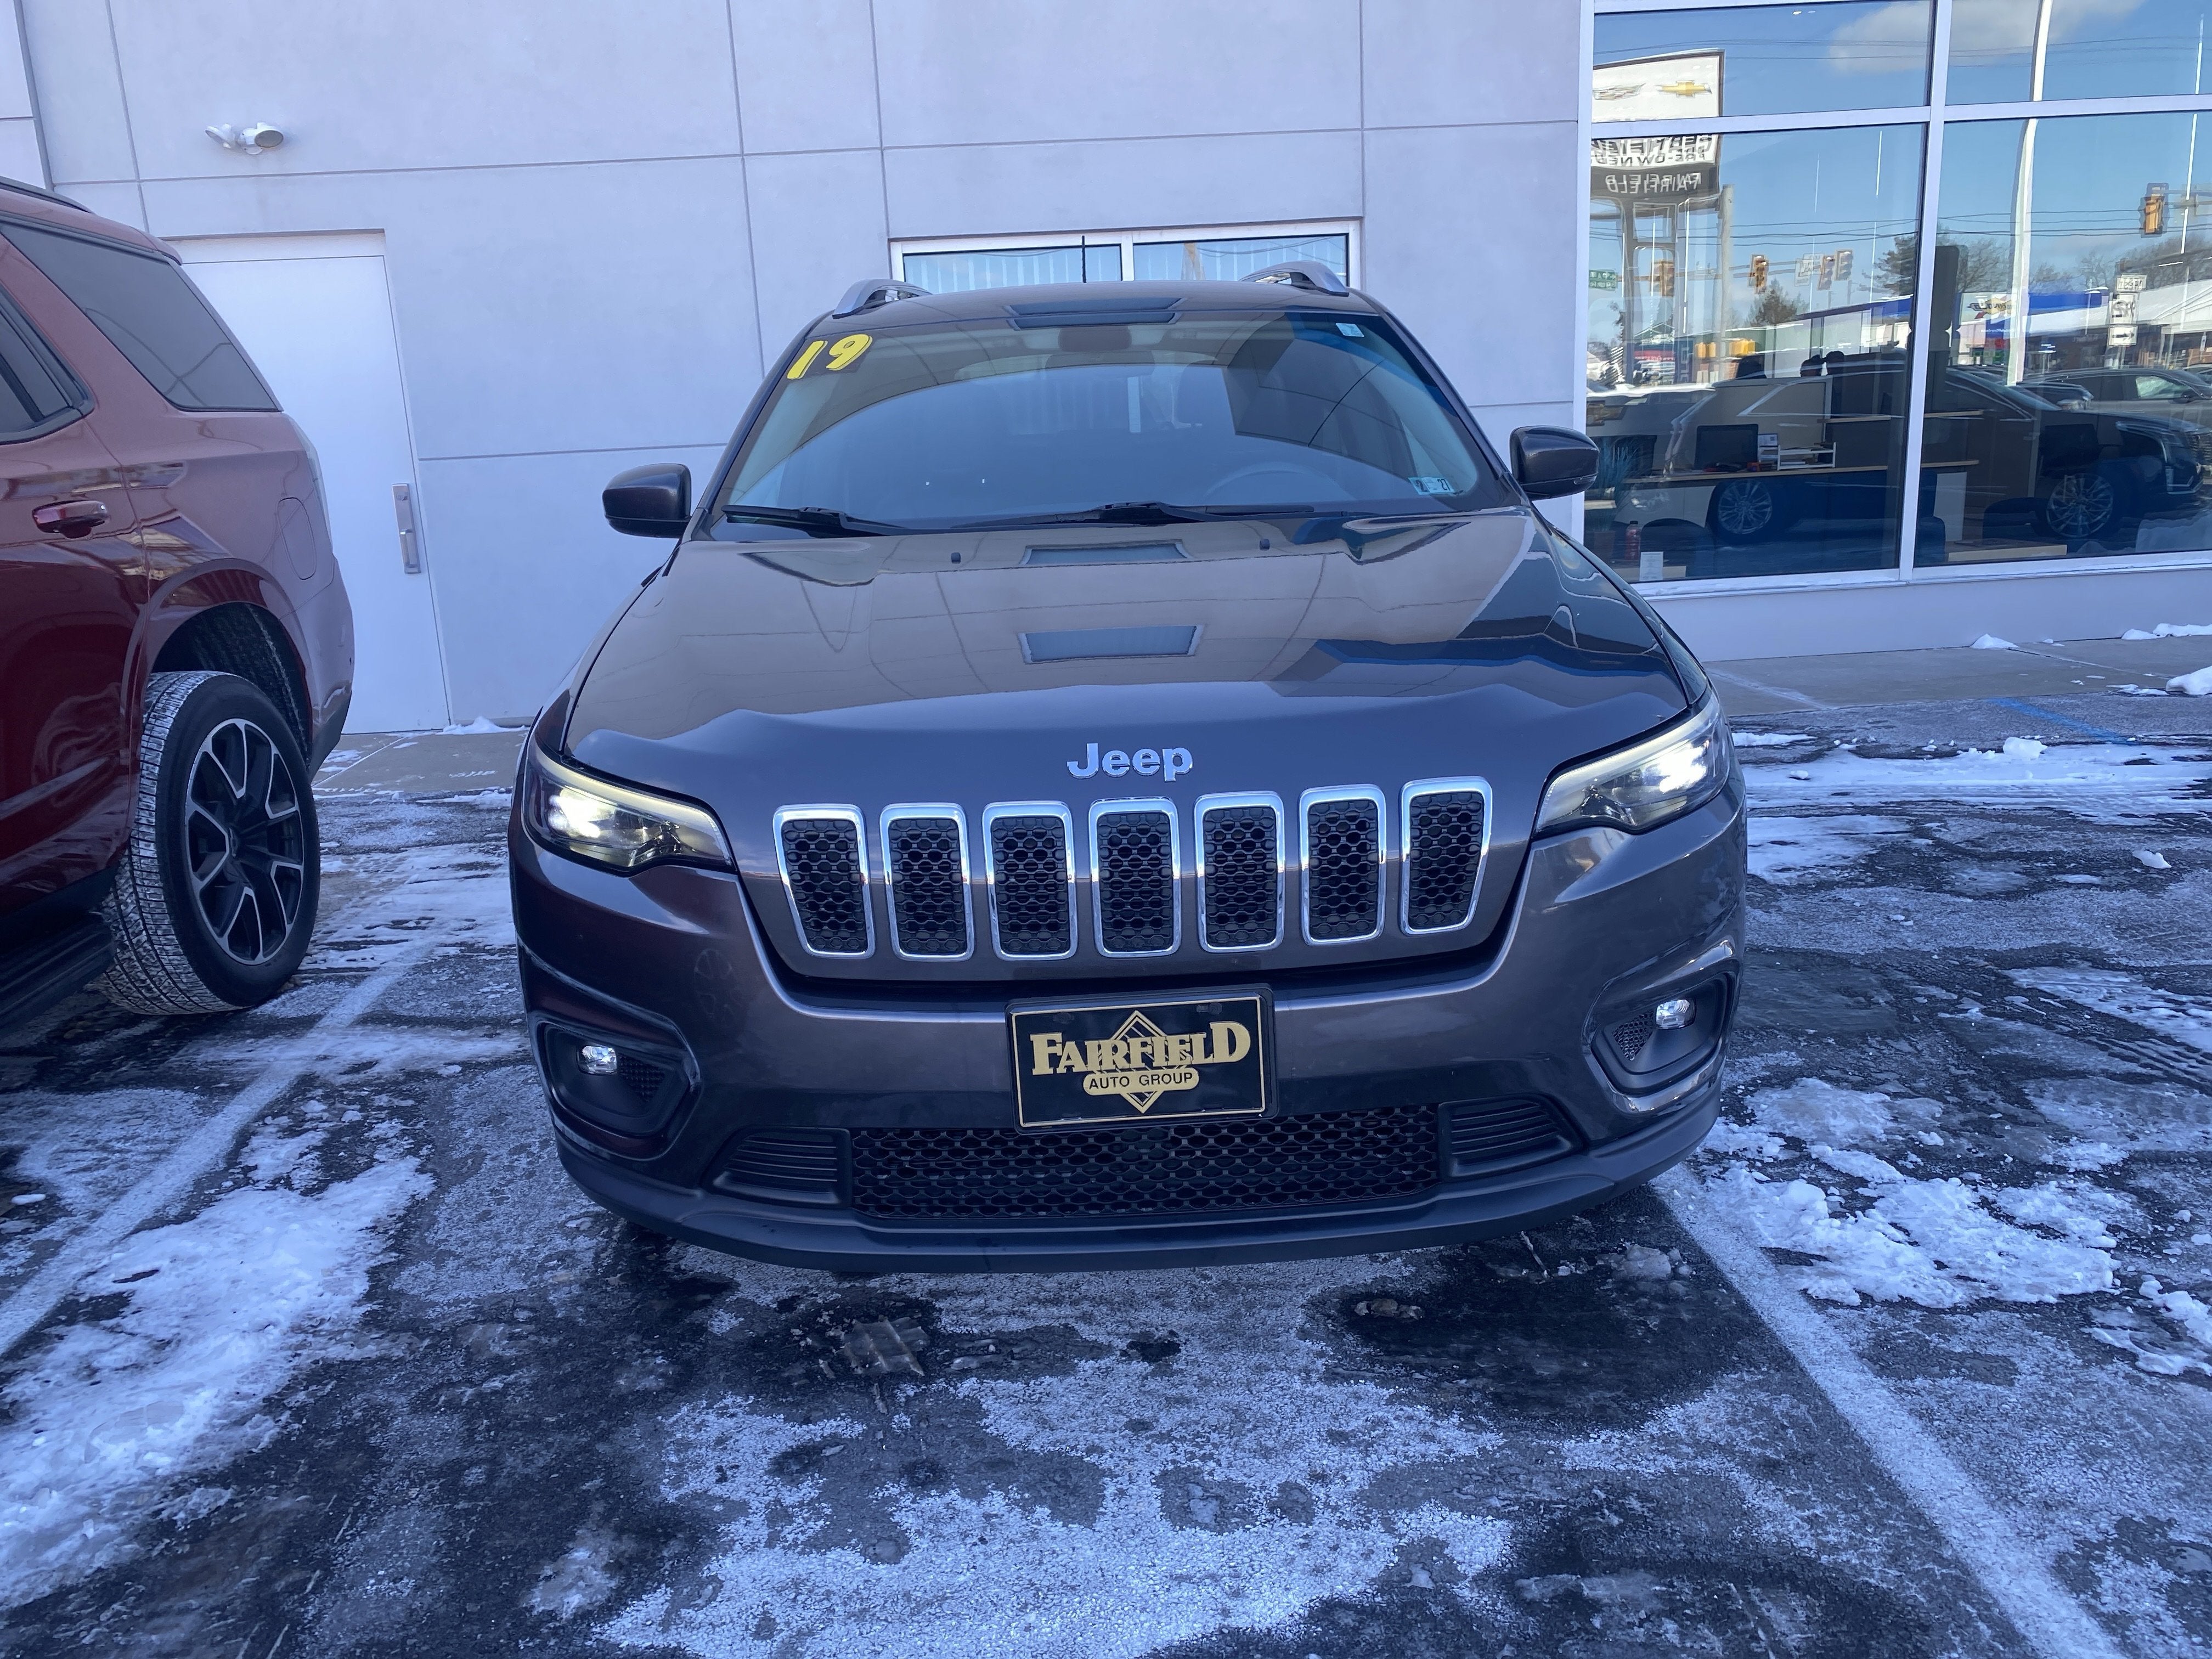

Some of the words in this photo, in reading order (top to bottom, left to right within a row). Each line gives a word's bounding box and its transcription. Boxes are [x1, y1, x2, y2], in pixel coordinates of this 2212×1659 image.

[787, 334, 873, 380] 19
[1067, 743, 1193, 782] Jeep
[1030, 1021, 1251, 1075] FAIRFIELD
[1089, 1075, 1130, 1090] AUTO
[1139, 1072, 1193, 1086] GROUP
